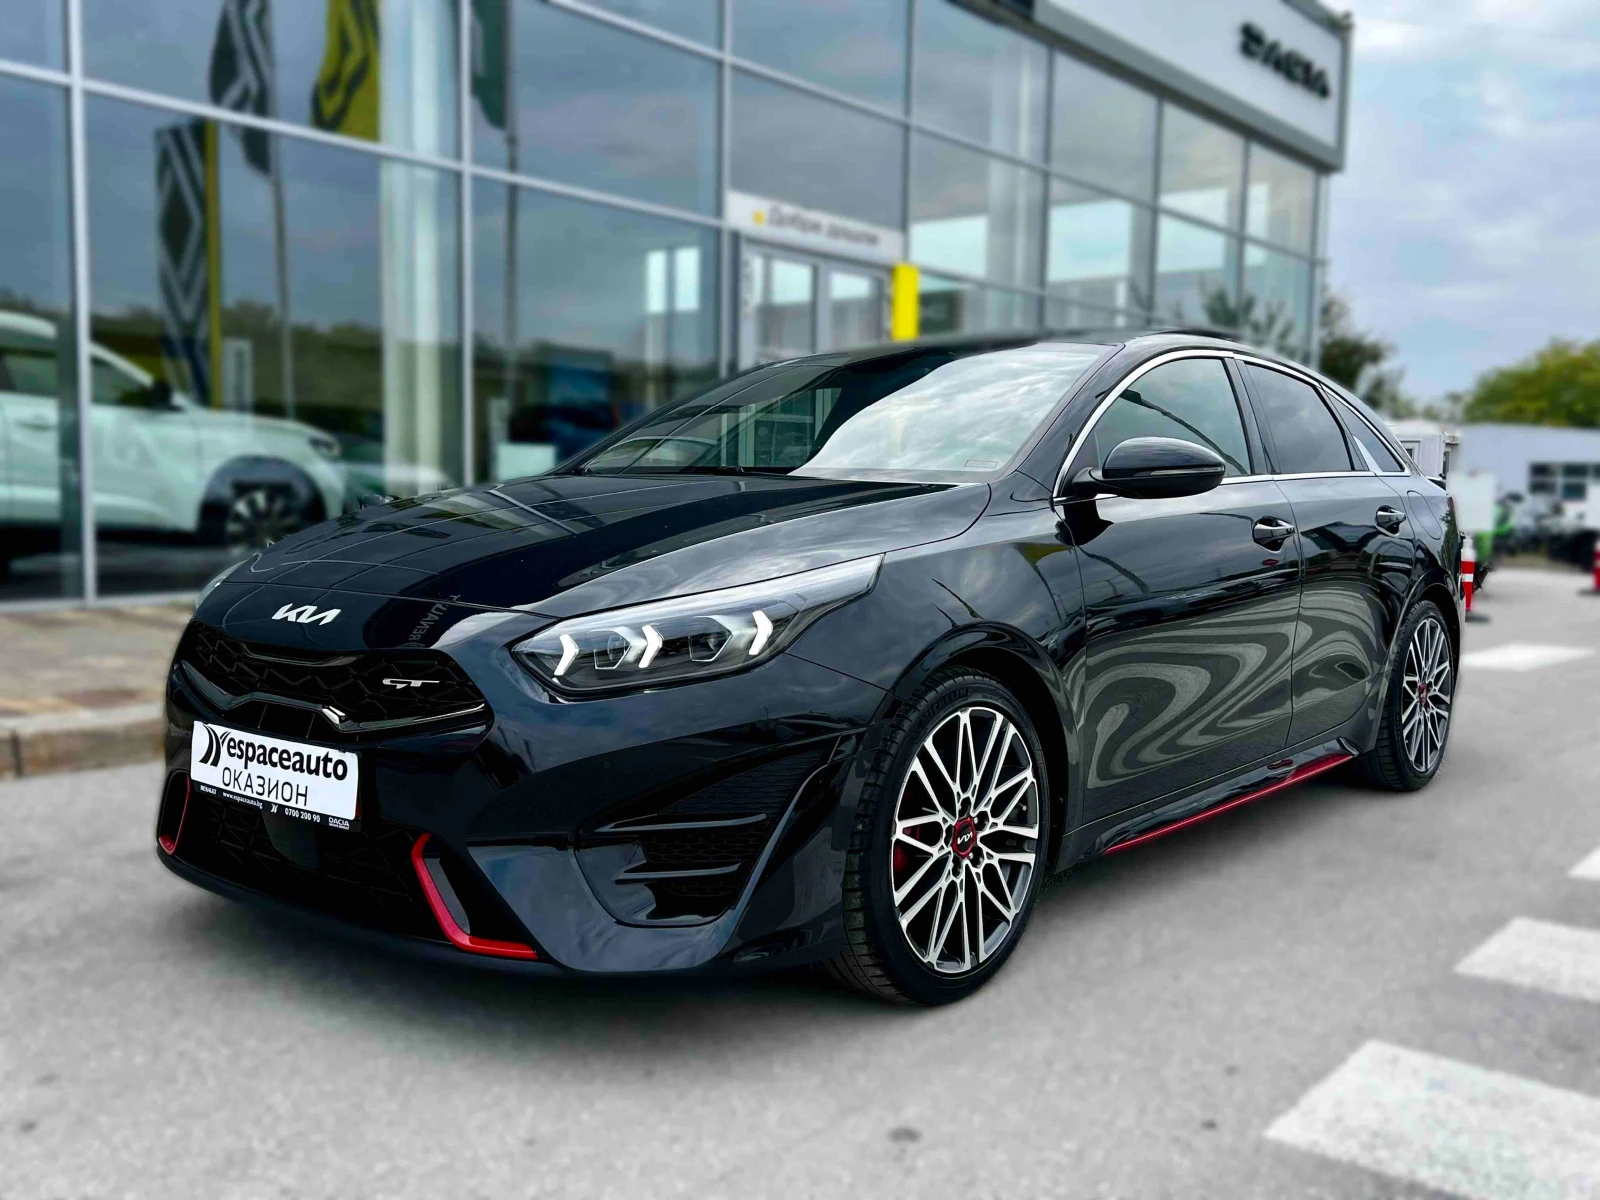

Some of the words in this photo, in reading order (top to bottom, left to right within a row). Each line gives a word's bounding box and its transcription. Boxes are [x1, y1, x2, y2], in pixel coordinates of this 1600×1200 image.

[382, 677, 440, 690] GT
[226, 736, 348, 781] espaceauto
[222, 766, 309, 807] ОКАЗИОН
[222, 791, 263, 810] www.espaceauto.bg
[284, 806, 300, 819] 0700
[300, 809, 312, 822] 200
[312, 813, 321, 823] 90
[328, 816, 350, 827] DACIA
